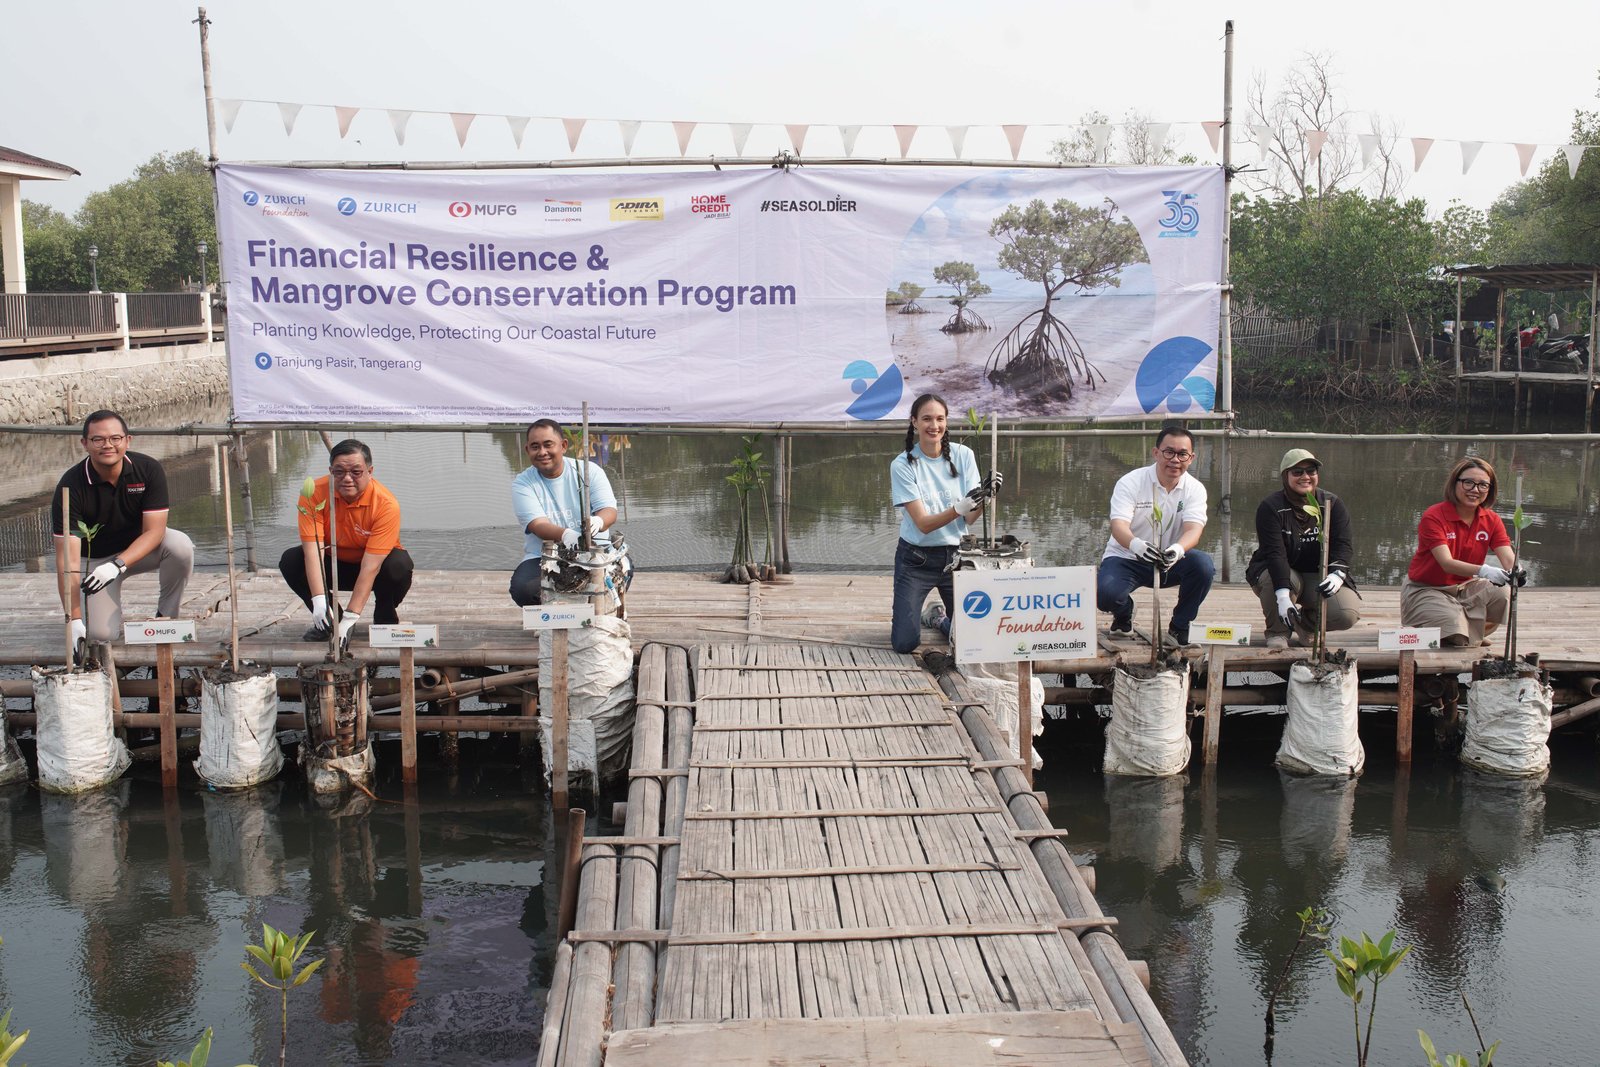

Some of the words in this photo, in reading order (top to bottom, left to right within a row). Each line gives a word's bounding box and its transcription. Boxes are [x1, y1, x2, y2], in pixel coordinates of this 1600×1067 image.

[264, 194, 305, 205] ZURICH
[691, 195, 726, 204] HOME
[760, 197, 857, 212] #SEASOLDIER
[262, 205, 309, 217] Foundation
[363, 202, 417, 214] ZURICH
[474, 203, 517, 216] MUFG
[544, 205, 582, 213] Danamon
[615, 202, 659, 210] ADIRA
[691, 204, 731, 213] CREDIT
[247, 239, 396, 269] Financial
[406, 243, 577, 271] Resilience
[586, 245, 609, 271] &
[251, 276, 417, 311] Mangrove
[426, 278, 647, 307] Conservation
[657, 279, 796, 312] Program
[252, 322, 318, 341] Planting
[322, 323, 416, 342] Knowledge,
[420, 324, 502, 343] Protecting
[507, 325, 537, 340] Our
[541, 325, 601, 340] Coastal
[606, 325, 657, 340] Future
[274, 355, 323, 369] Tanjung
[326, 356, 357, 369] Pasir,
[359, 357, 422, 371] Tangerang
[1001, 593, 1081, 611] ZURICH
[997, 615, 1085, 636] Foundation
[1031, 641, 1087, 651] #SEASOLDIER
